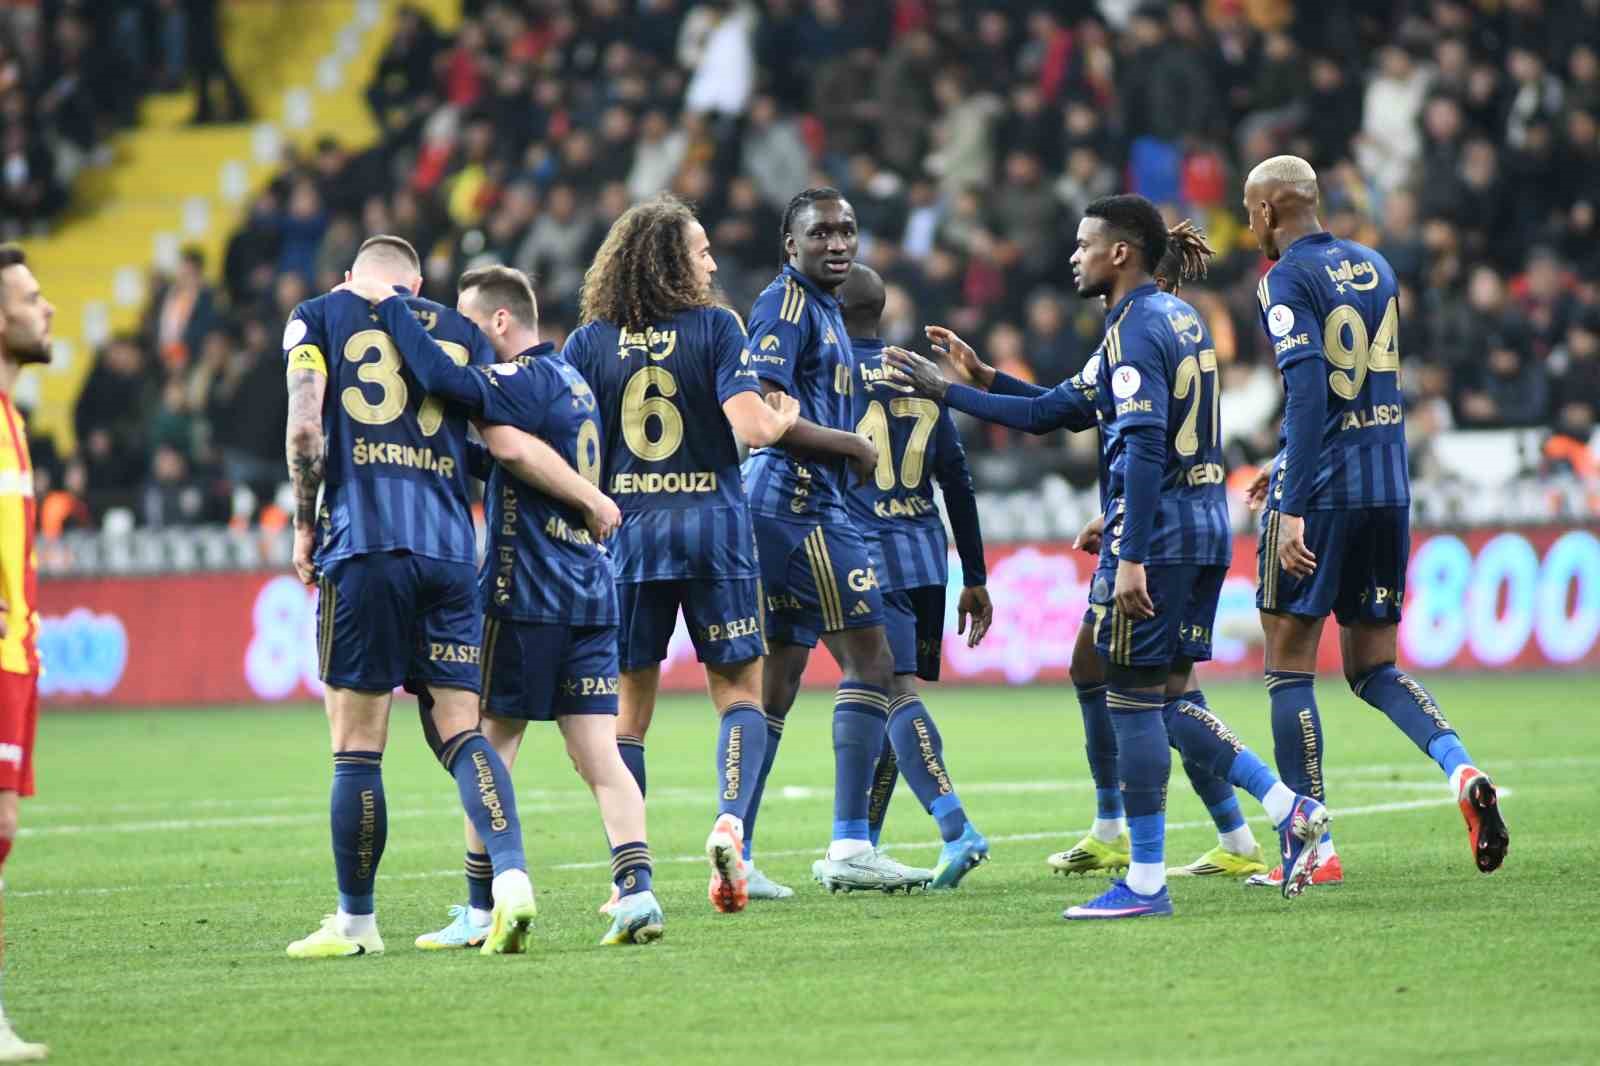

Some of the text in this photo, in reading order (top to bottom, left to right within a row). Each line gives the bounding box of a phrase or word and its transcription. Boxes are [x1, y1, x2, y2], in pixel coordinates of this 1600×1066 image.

[1324, 296, 1401, 400] 94
[621, 366, 684, 462] 6
[856, 397, 940, 490] 17
[1173, 348, 1217, 457] 27
[1400, 530, 1600, 669] 800
